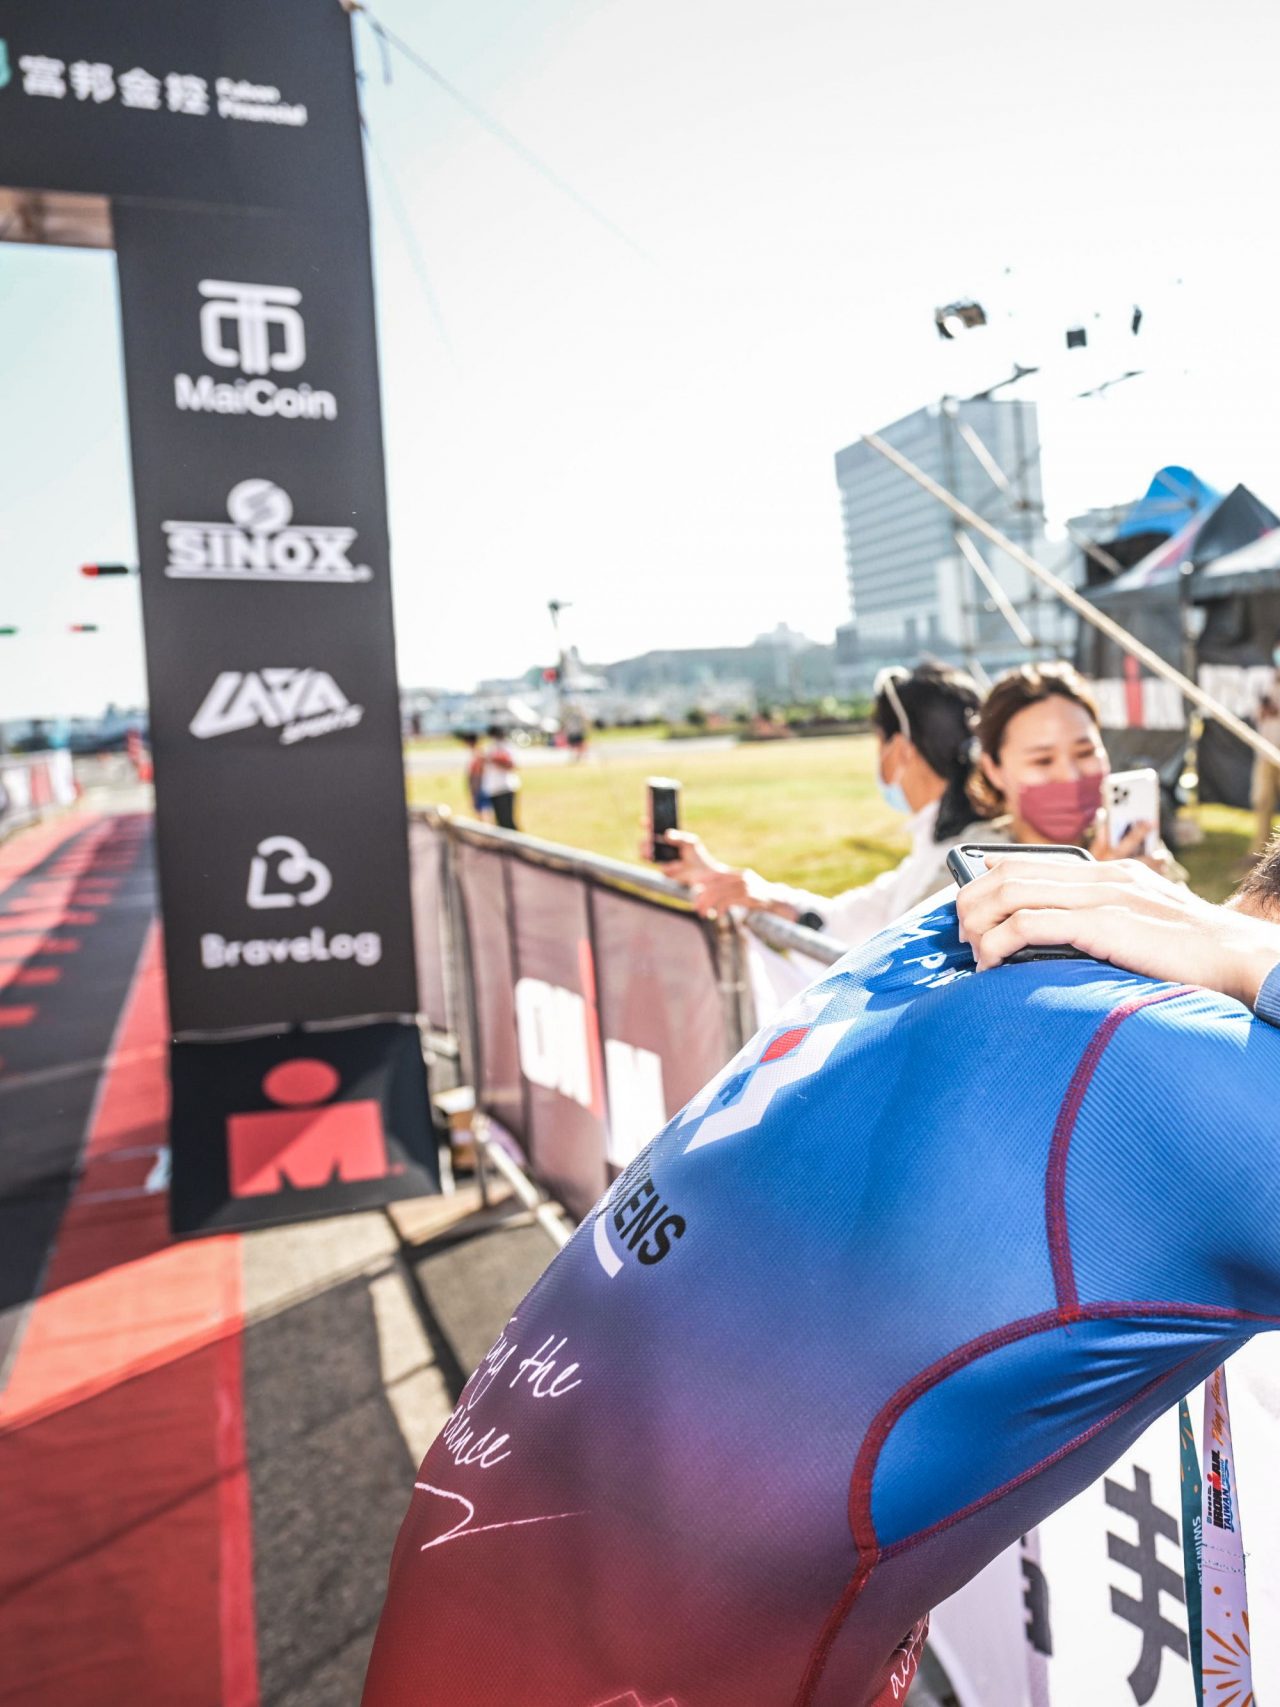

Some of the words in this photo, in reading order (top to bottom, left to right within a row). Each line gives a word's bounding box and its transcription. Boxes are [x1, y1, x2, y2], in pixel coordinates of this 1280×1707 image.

[174, 373, 338, 421] MaiCoin
[163, 523, 357, 581] SINOX
[189, 667, 352, 739] LAVA
[201, 927, 382, 969] BraveLog
[613, 1175, 687, 1265] ENS
[509, 1334, 582, 1398] the
[1221, 1488, 1232, 1531] TAIWAN
